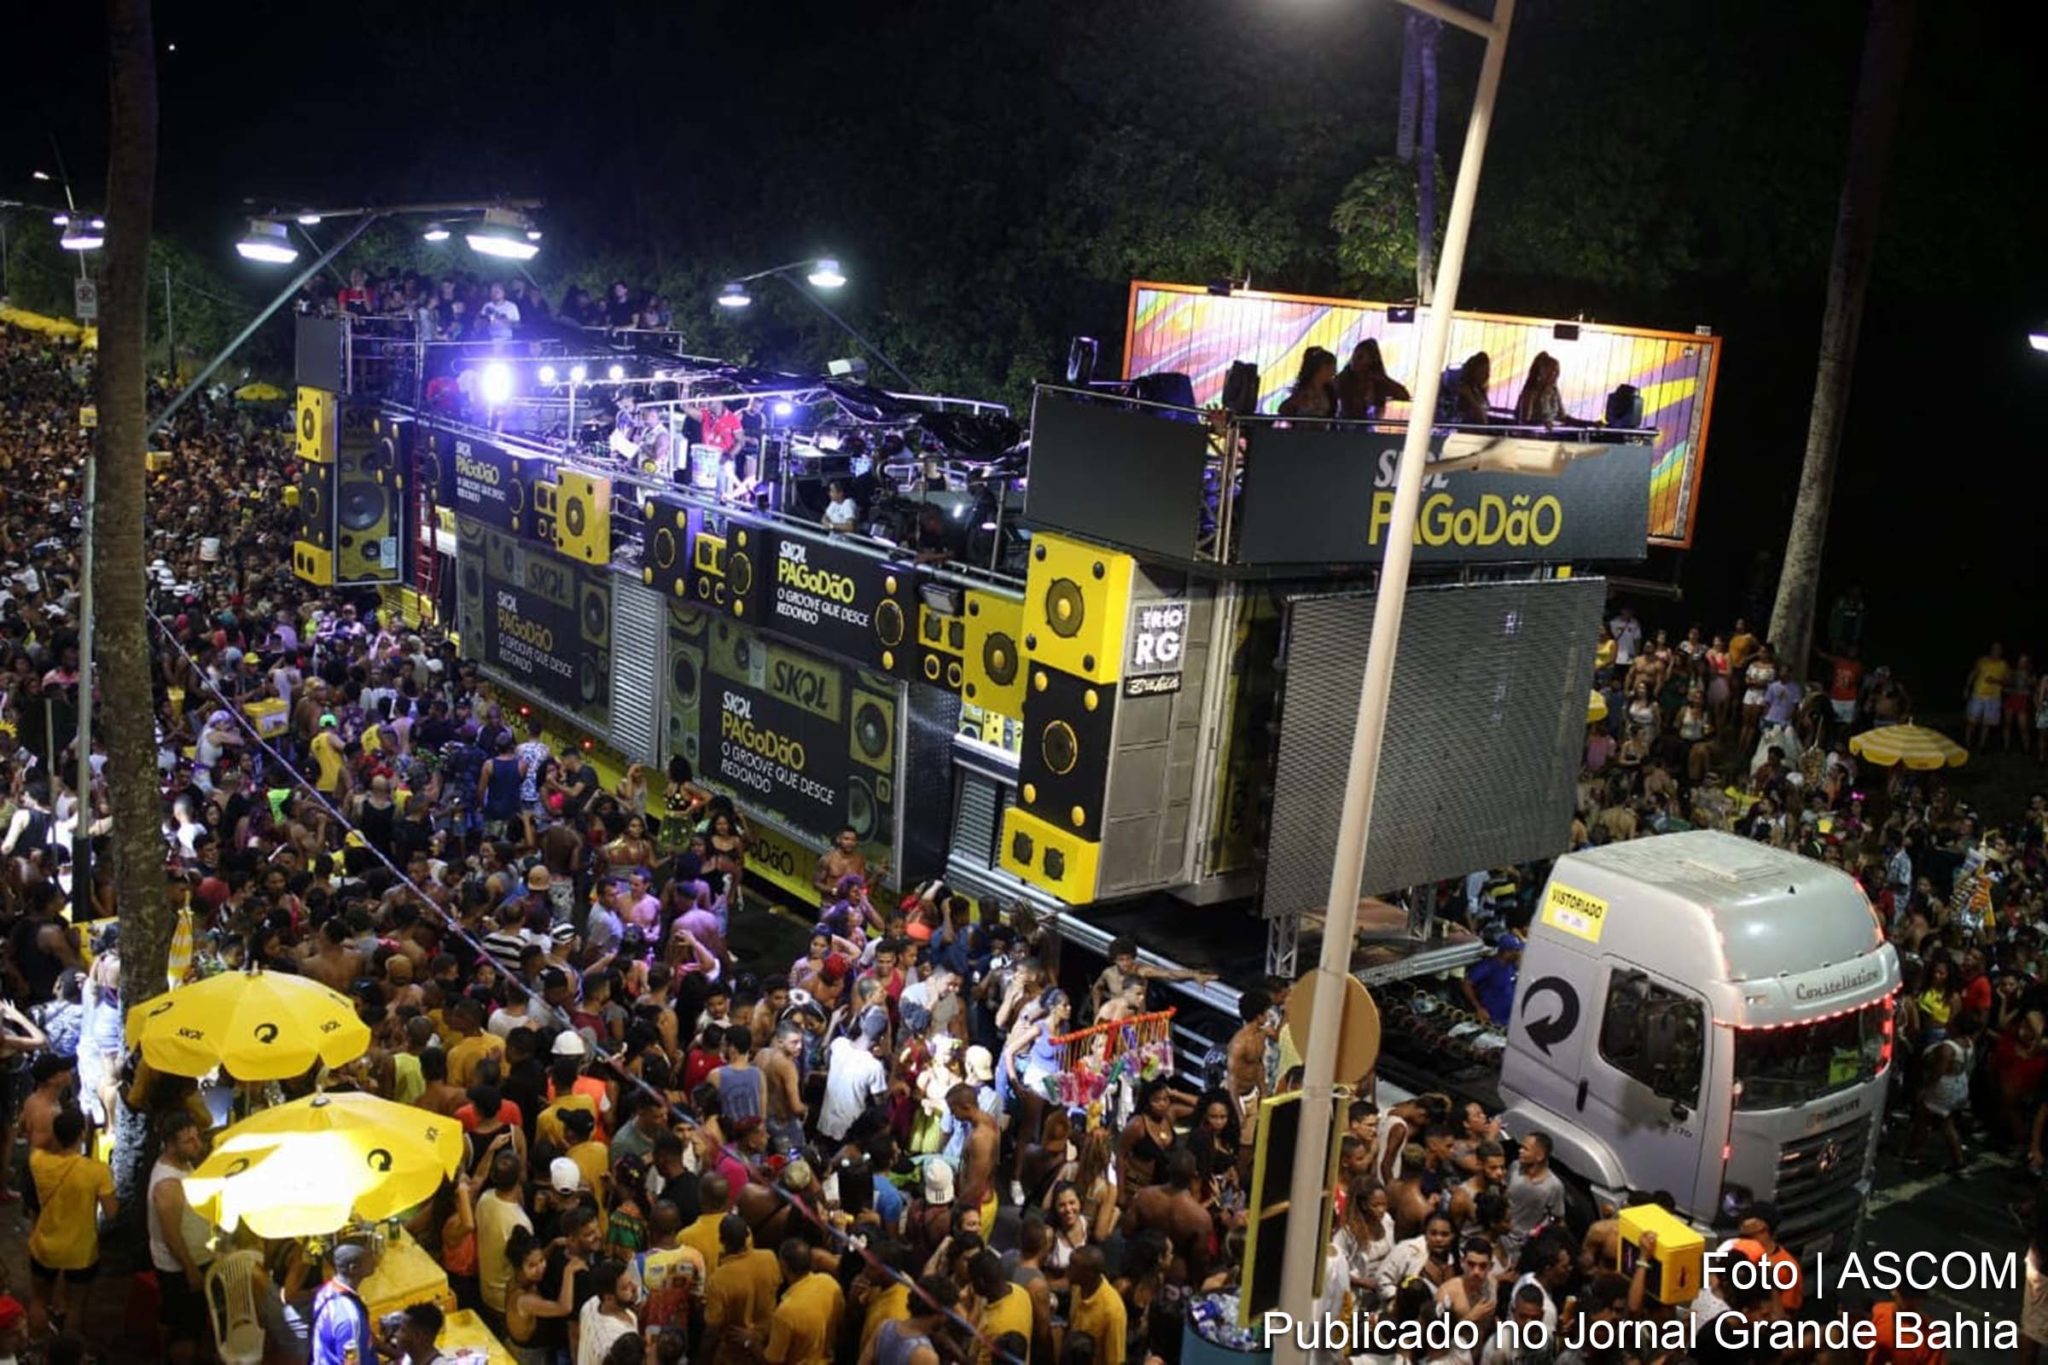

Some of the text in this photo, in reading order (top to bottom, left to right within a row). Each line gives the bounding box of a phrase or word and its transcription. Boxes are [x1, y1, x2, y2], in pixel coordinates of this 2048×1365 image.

[1368, 491, 1563, 546] PGoDãO
[779, 540, 807, 564] SKOL
[778, 558, 856, 604] PAGoDãO
[497, 591, 518, 613] SKOL
[776, 601, 819, 625] REDONDO
[777, 587, 870, 628] O GROOVE QUE DESCE
[1142, 609, 1183, 629] TRIO
[498, 608, 553, 653] PAGoDãO
[1135, 631, 1180, 665] RG
[499, 647, 533, 674] REDONDO
[505, 635, 534, 660] GROOVE
[533, 650, 549, 668] QUE
[549, 656, 574, 679] DESCE
[773, 659, 829, 710] SKOL
[722, 691, 752, 719] SKOL
[722, 711, 805, 770] PAGoDãO
[721, 741, 836, 806] O GROOVE QUE DESCE
[721, 759, 772, 794] REDONDO
